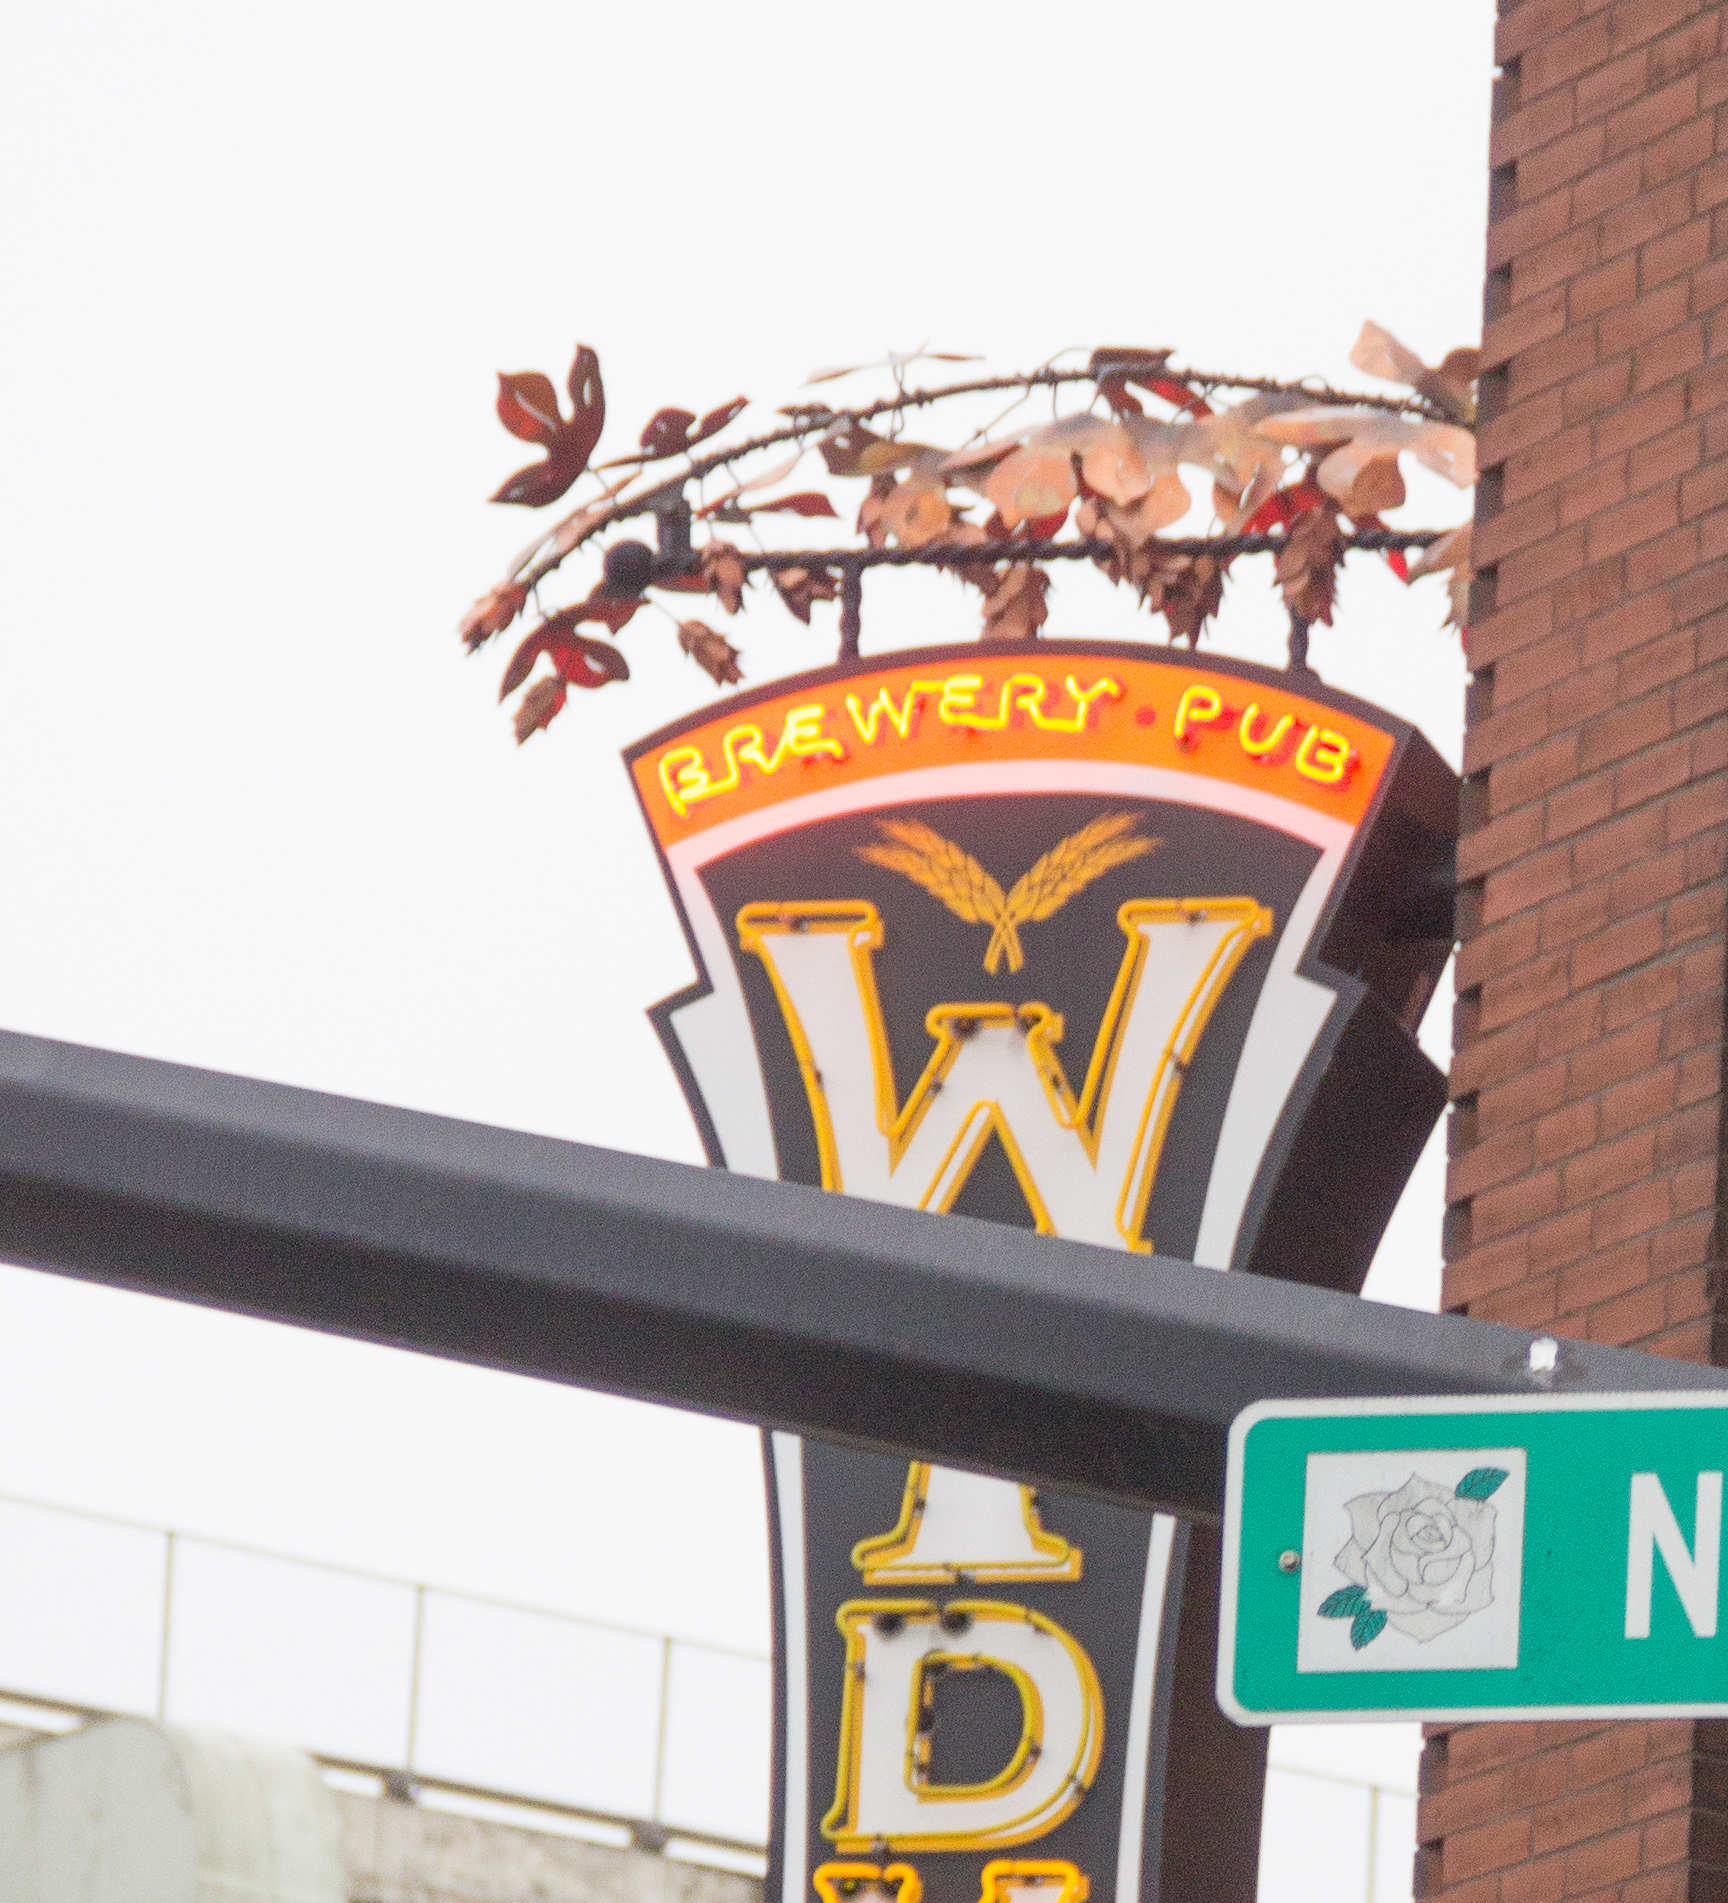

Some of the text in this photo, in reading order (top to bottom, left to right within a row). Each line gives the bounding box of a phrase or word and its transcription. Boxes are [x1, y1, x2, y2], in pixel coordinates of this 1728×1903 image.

[657, 671, 1358, 818] BREWERY PUB
[1624, 1470, 1724, 1640] N
